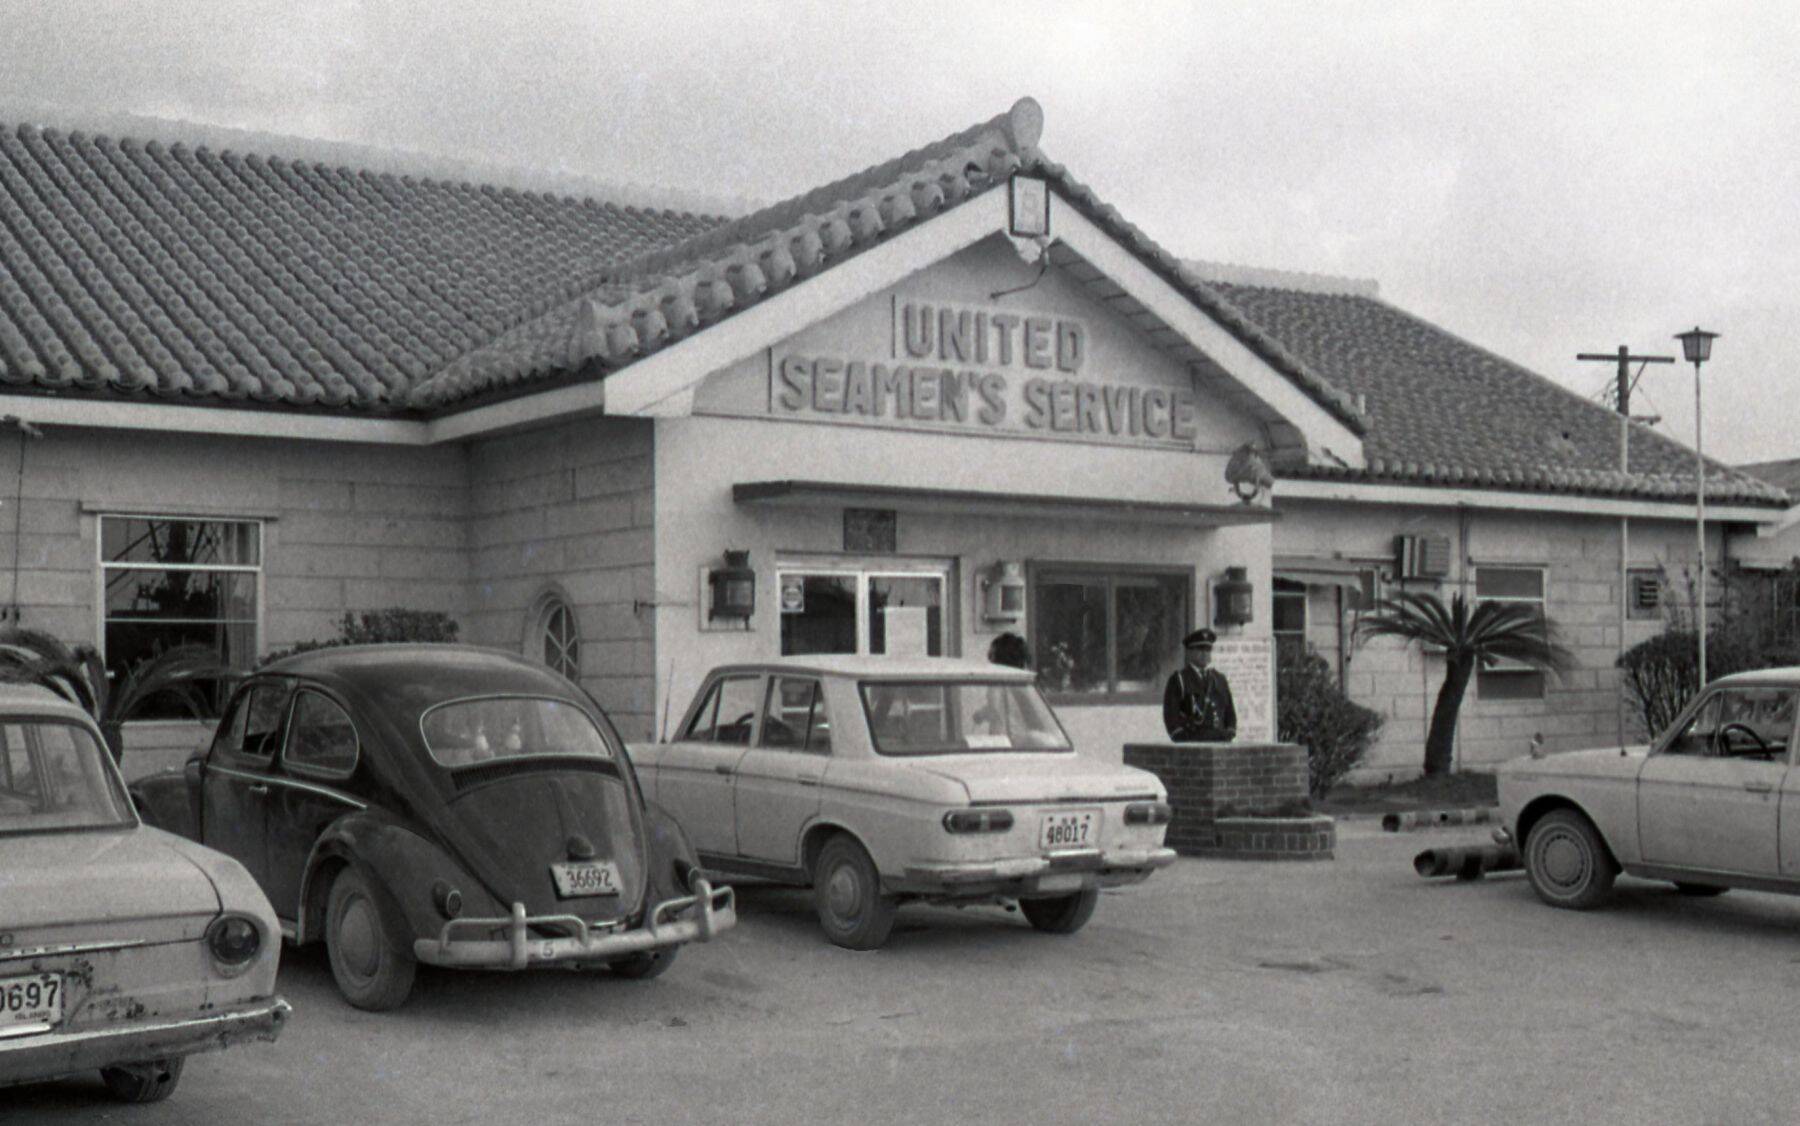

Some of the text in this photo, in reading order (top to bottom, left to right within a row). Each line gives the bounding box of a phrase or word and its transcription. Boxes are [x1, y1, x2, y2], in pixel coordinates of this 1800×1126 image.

[904, 304, 1082, 374] UNITED
[779, 355, 1197, 441] SEAMEN'S SERVICE
[1047, 823, 1089, 844] 48017
[565, 868, 613, 889] 36692
